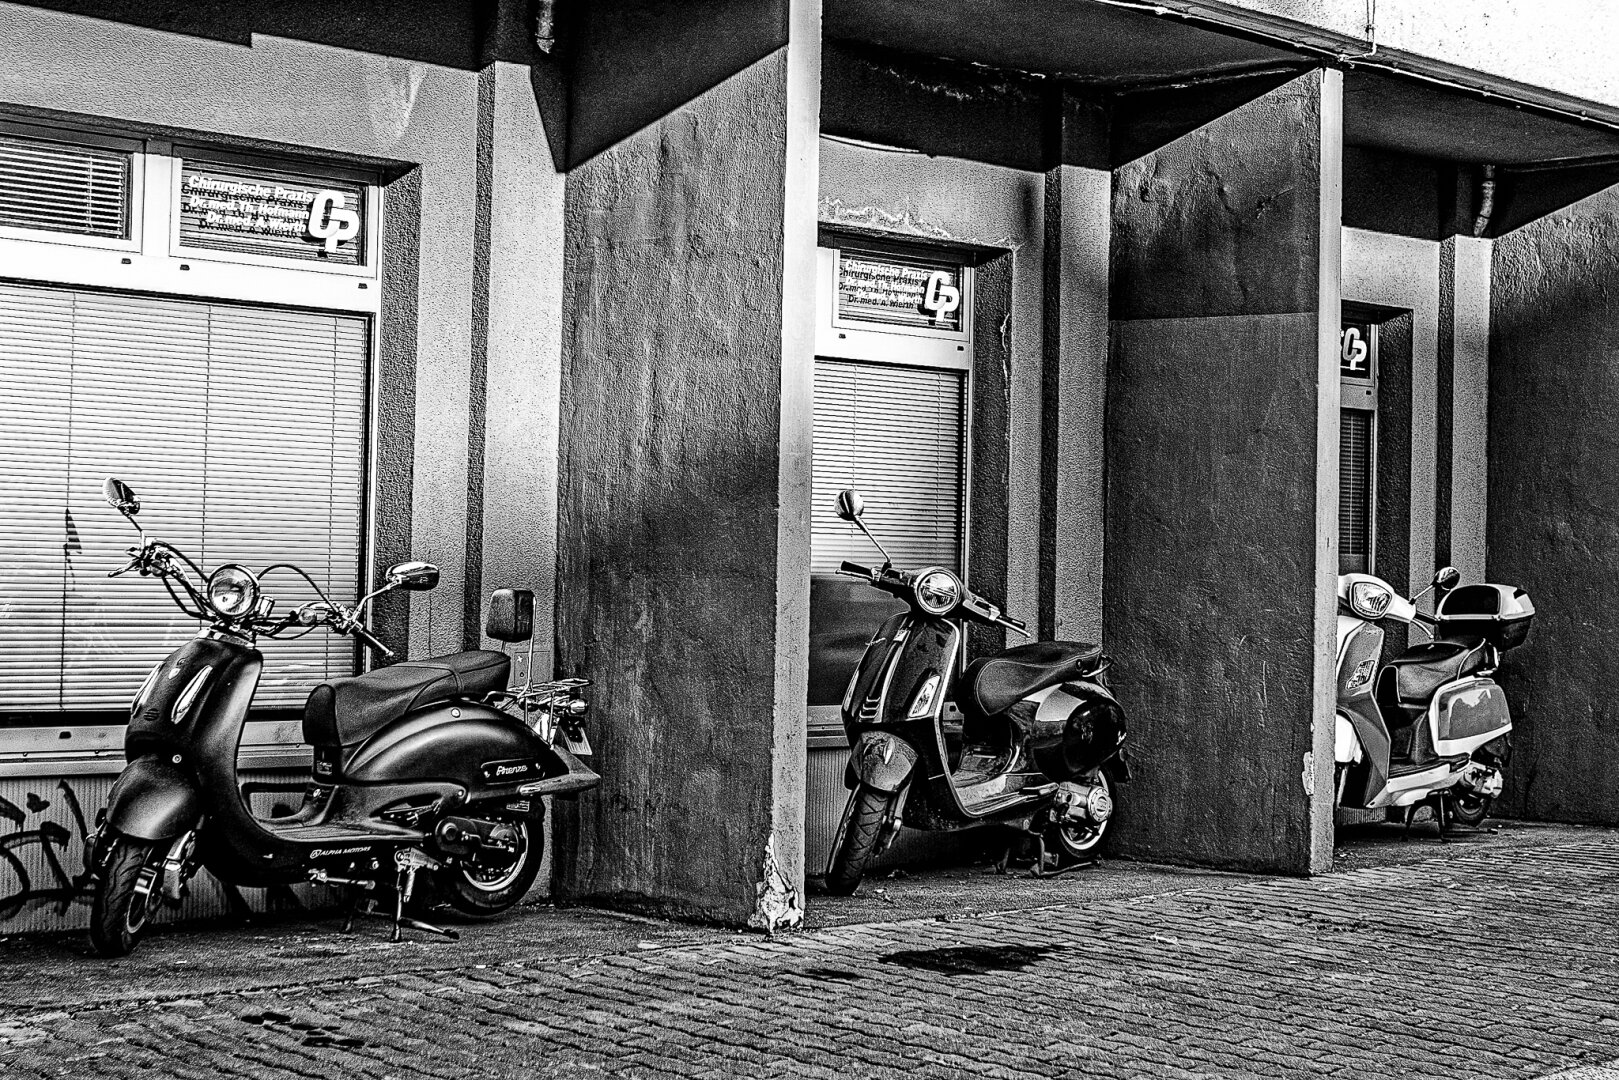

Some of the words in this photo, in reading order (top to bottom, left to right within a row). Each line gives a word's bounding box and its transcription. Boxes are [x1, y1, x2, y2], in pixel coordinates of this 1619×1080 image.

[189, 175, 272, 198] Chirurgische
[274, 186, 314, 203] Praxis
[845, 259, 901, 278] Chirurgische
[902, 268, 928, 281] Praxis
[319, 848, 343, 857] ALPHA
[342, 845, 372, 854] MOTORS
